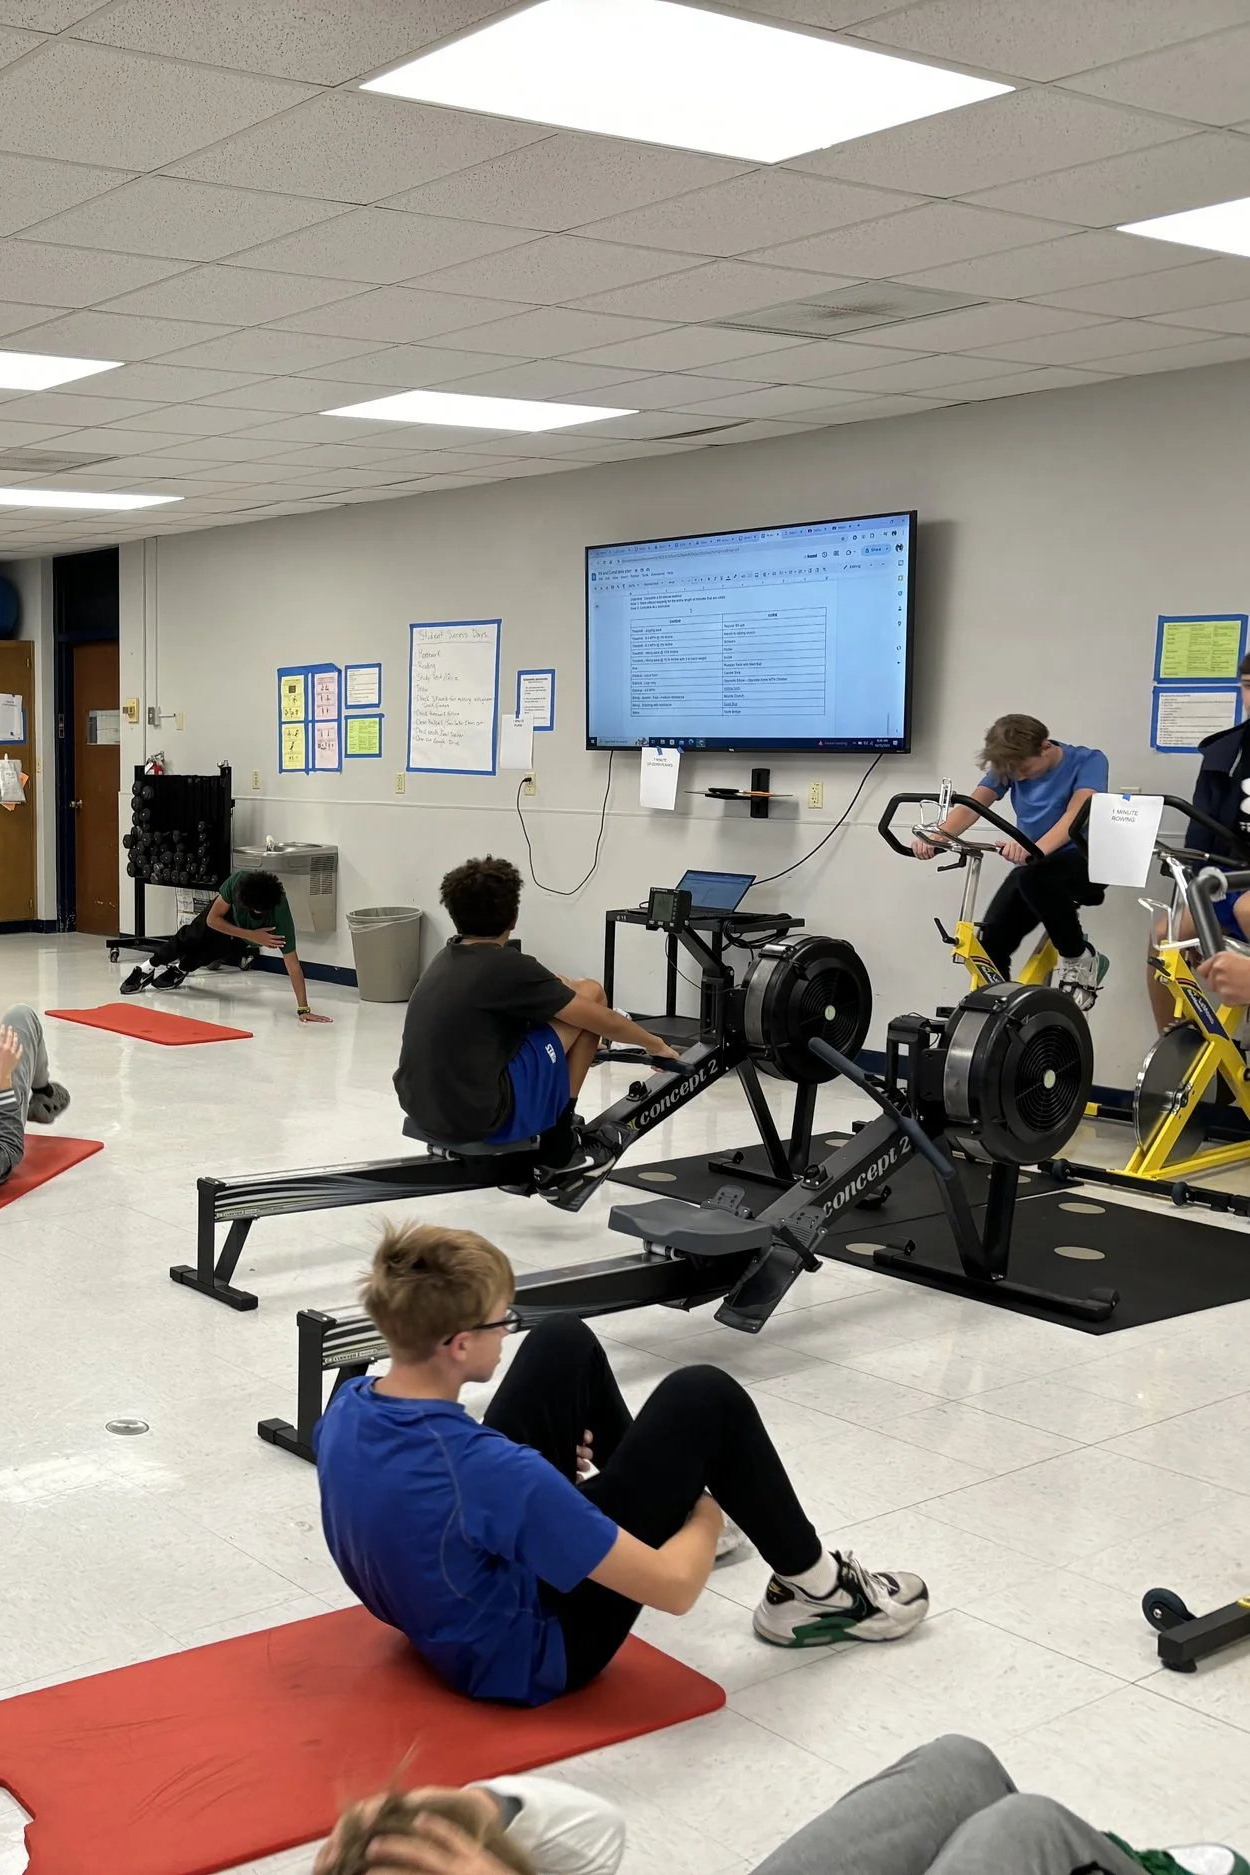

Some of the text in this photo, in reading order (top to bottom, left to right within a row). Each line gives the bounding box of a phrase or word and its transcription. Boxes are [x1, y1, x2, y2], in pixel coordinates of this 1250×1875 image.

[418, 628, 488, 641] Student Success Days
[1111, 815, 1135, 823] ROWING
[639, 1059, 719, 1126] concept 2
[822, 1135, 912, 1218] concept 2
